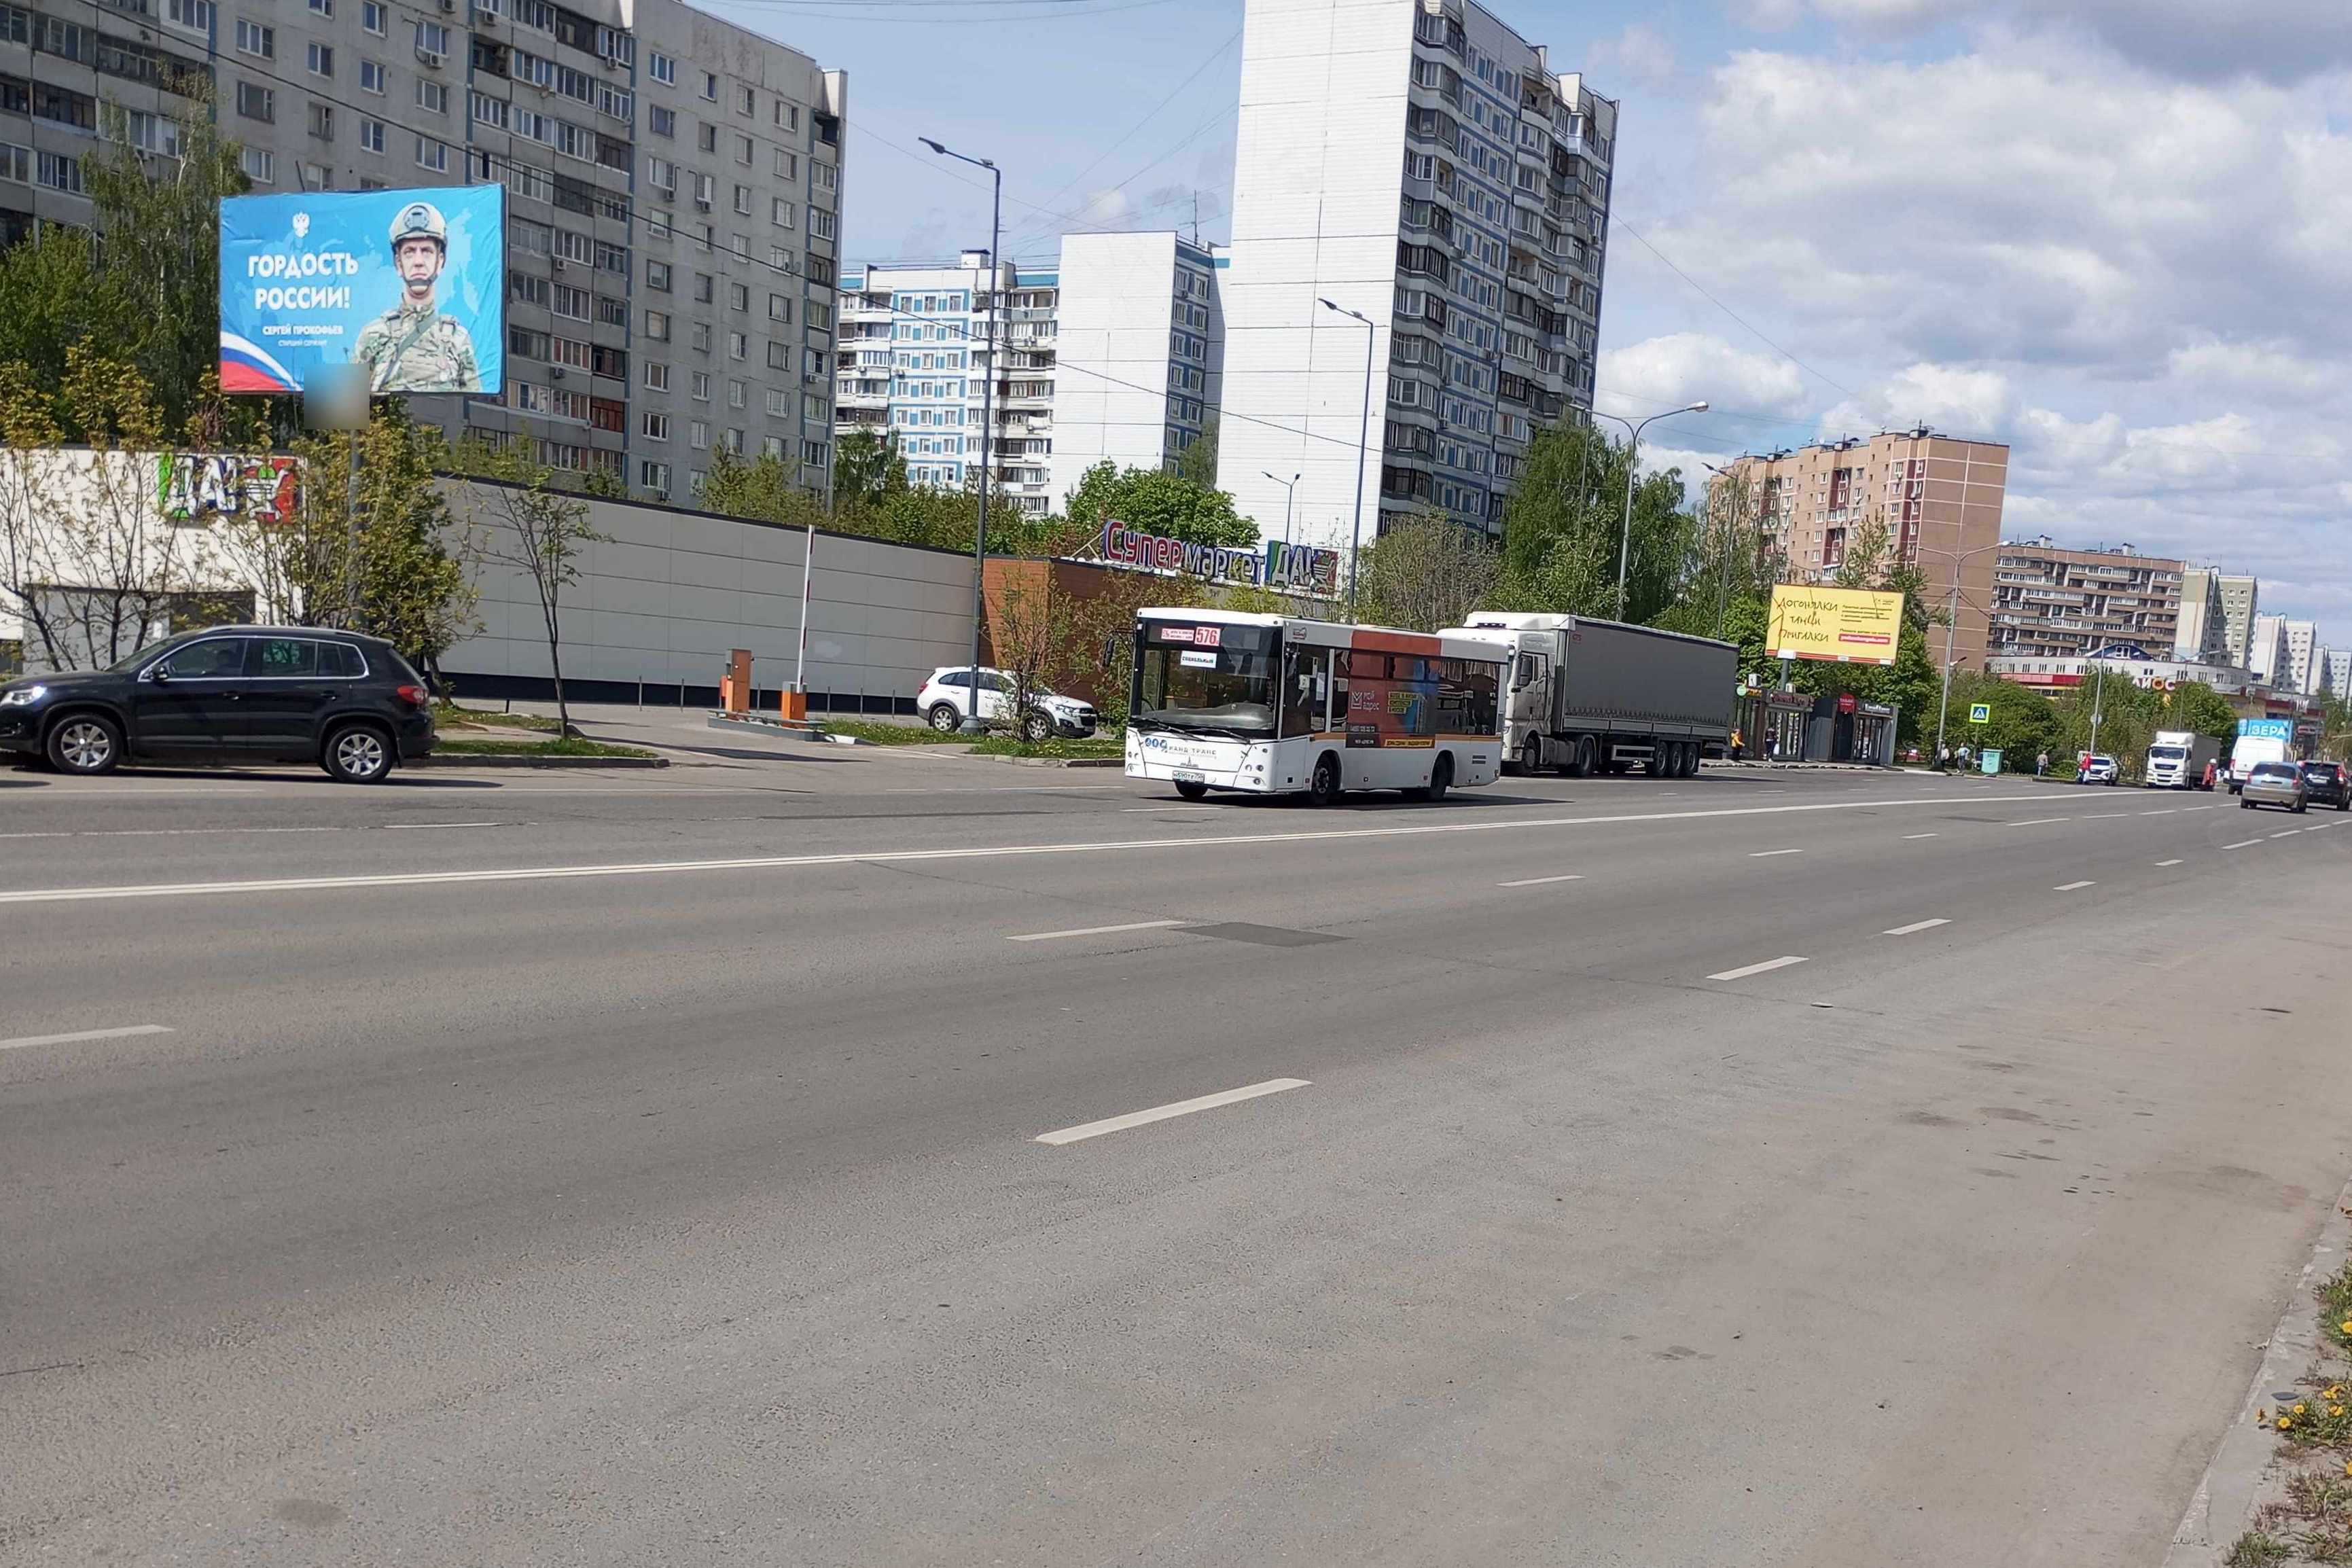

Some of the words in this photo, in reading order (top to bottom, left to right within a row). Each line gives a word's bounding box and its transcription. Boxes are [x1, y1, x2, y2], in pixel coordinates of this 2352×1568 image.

[248, 252, 359, 279] ГОРДОСТЬ
[255, 286, 351, 310] РОССИИ!
[1105, 521, 1265, 585] Супермаркет
